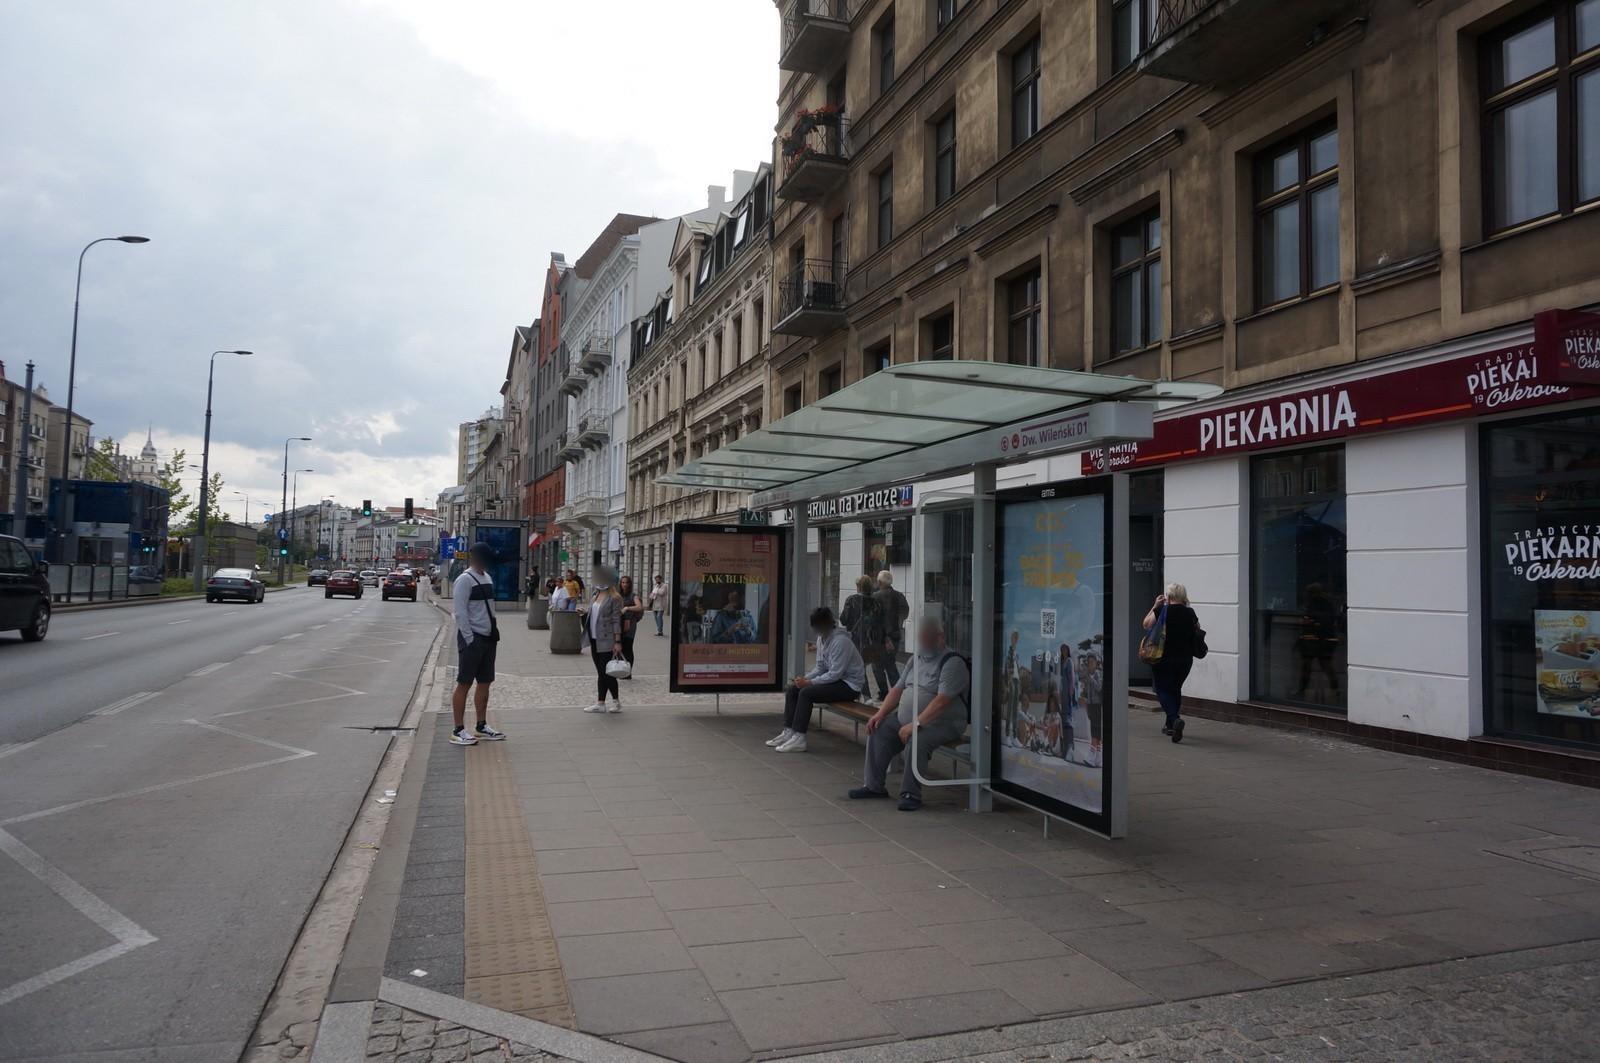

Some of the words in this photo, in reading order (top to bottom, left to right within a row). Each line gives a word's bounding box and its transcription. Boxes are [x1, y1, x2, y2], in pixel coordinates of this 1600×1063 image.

[1475, 394, 1484, 404] 19
[1199, 390, 1357, 452] PIEKARNIA
[1022, 435, 1038, 448] Dw.
[1039, 423, 1076, 444] Wileński
[1077, 421, 1088, 435] 01
[1090, 442, 1138, 461] PIEARNIA
[839, 497, 852, 513] na
[701, 573, 724, 585] TAK
[1513, 566, 1523, 576] 19
